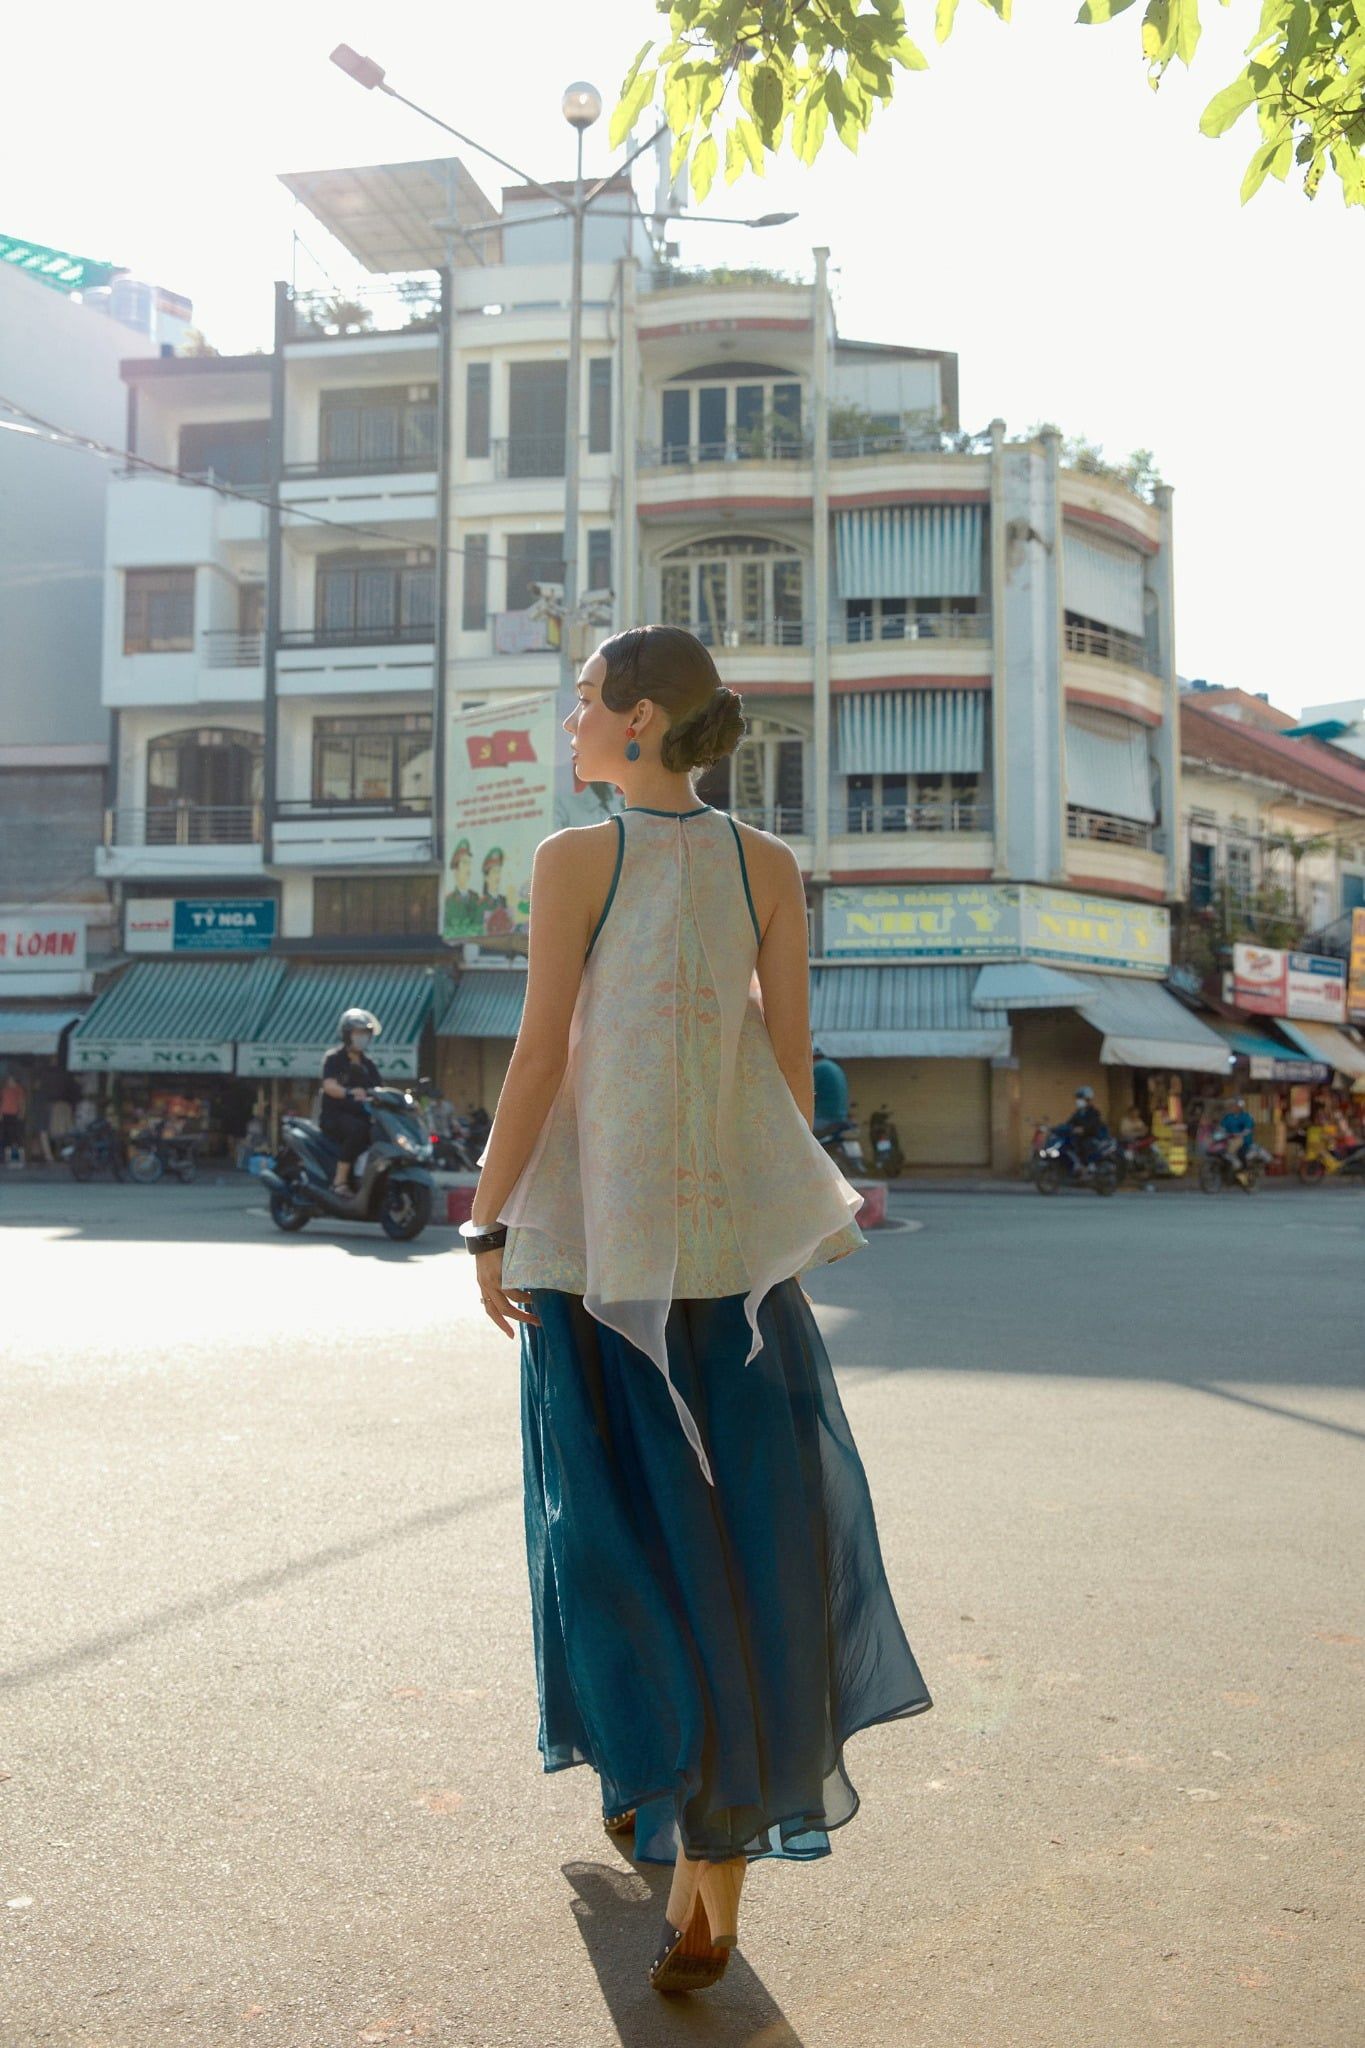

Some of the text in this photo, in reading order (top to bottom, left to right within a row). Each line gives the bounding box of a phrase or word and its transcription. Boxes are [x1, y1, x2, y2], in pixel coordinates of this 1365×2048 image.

[218, 912, 257, 927] NGA
[16, 931, 77, 956] LOAN
[153, 1051, 220, 1063] NGA
